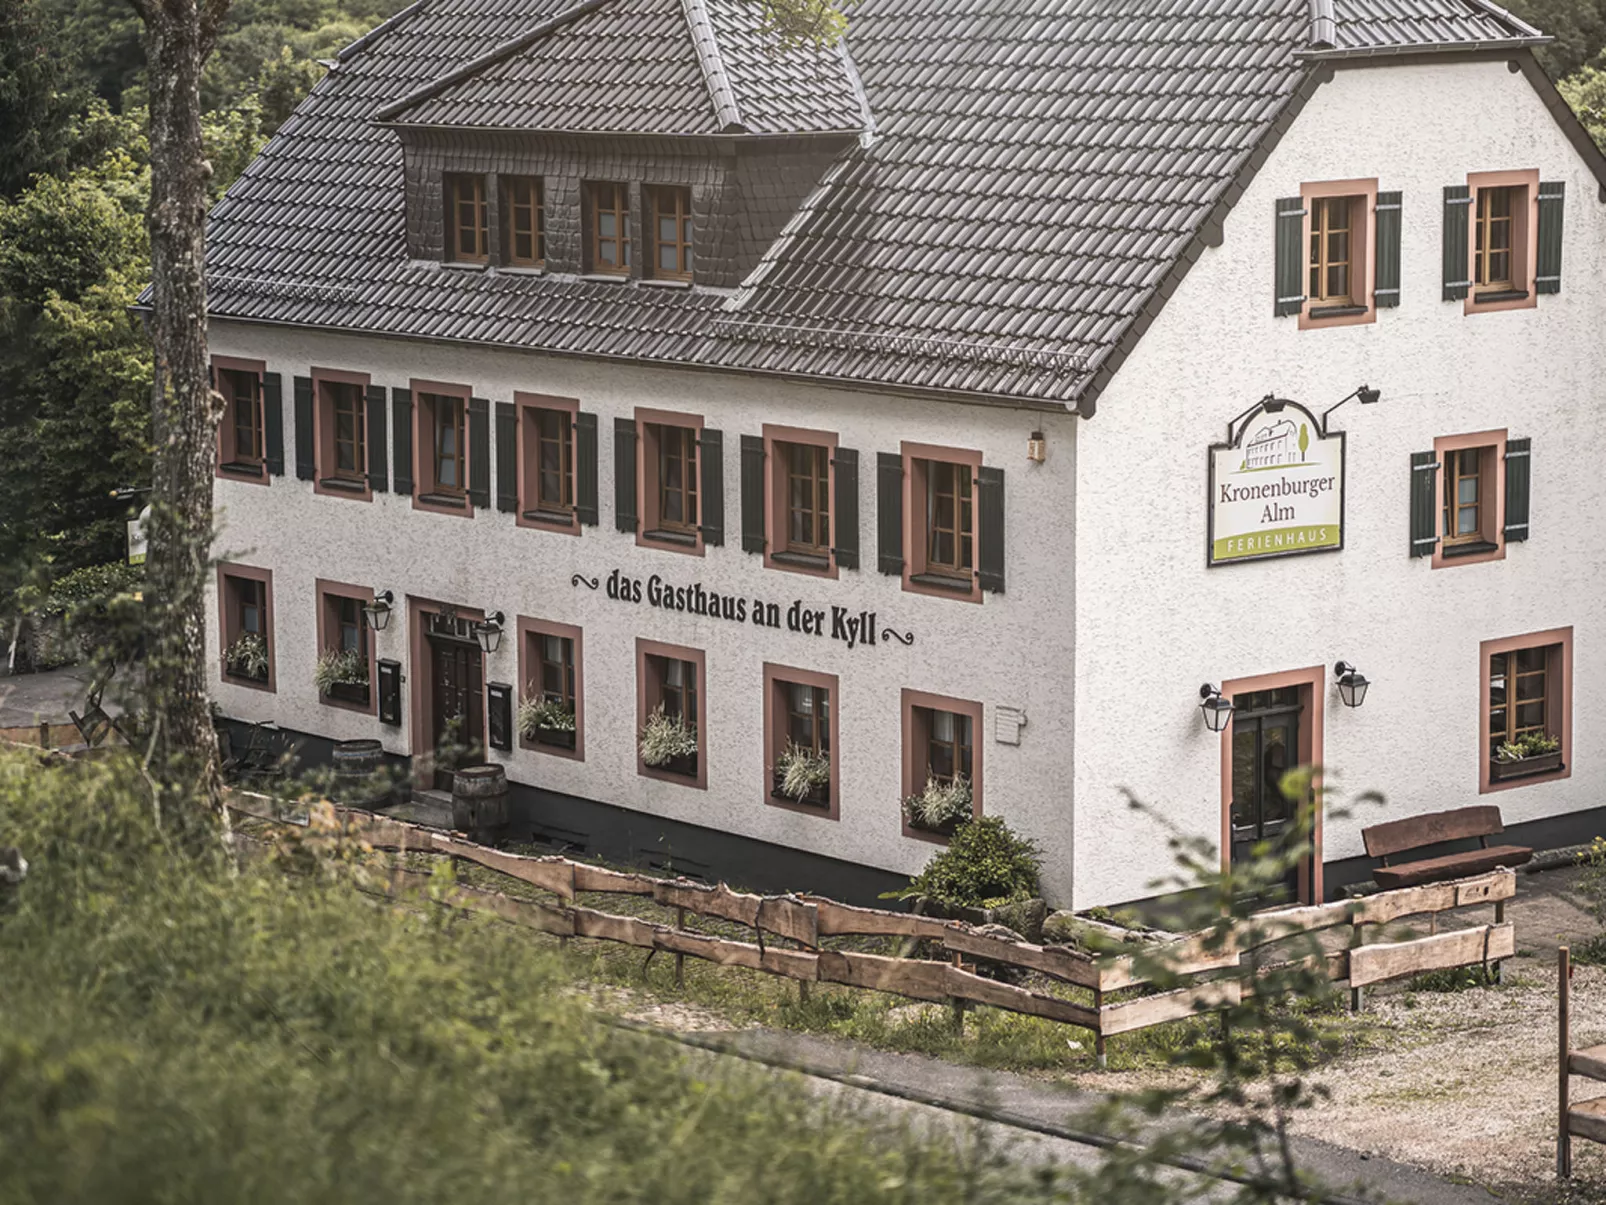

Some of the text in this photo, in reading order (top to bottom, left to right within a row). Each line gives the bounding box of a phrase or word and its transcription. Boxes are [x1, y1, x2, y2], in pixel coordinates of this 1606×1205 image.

[1220, 477, 1335, 503] Kronenburger
[1260, 503, 1295, 523] Alm
[1227, 528, 1327, 552] FERIENHAUS
[606, 569, 876, 648] das Gasthaus an der Kyll
